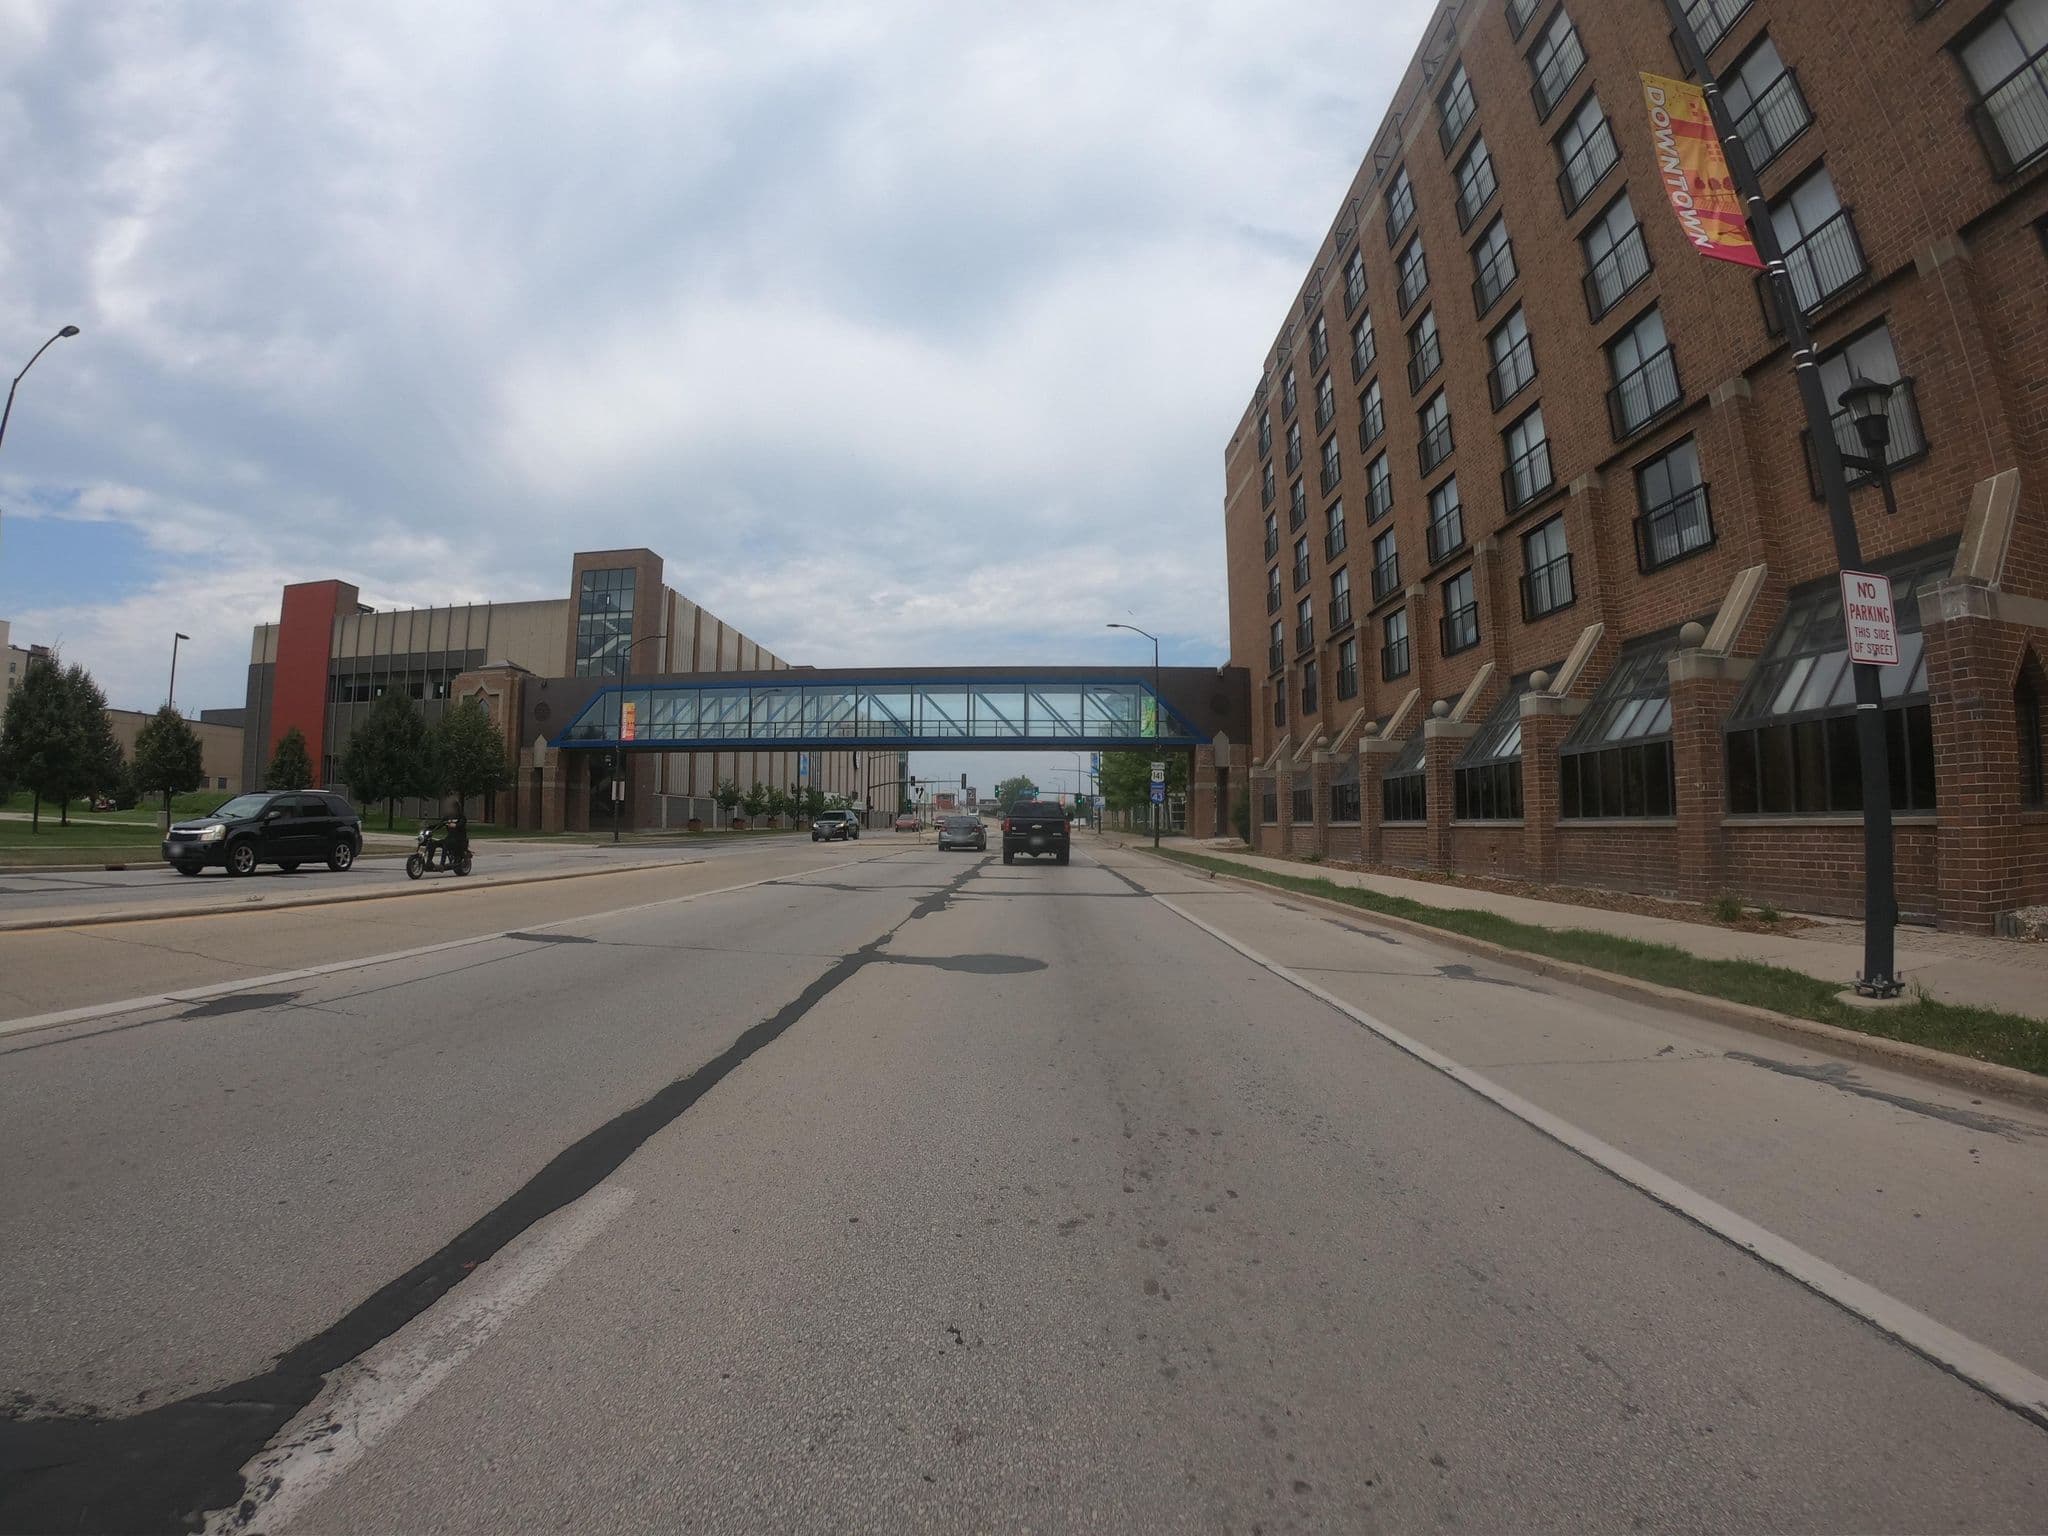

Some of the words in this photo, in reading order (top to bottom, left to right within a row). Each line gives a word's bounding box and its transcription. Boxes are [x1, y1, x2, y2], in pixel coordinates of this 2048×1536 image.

[1647, 86, 1714, 250] DOWNTOWN
[1857, 582, 1876, 599] NO
[1849, 603, 1890, 624] PARKING
[1854, 626, 1871, 639] THIS
[1874, 628, 1890, 641] SIDE
[1854, 642, 1863, 653] OF
[1867, 643, 1893, 656] STREET
[1153, 771, 1163, 780] 141
[1152, 793, 1163, 802] 43
